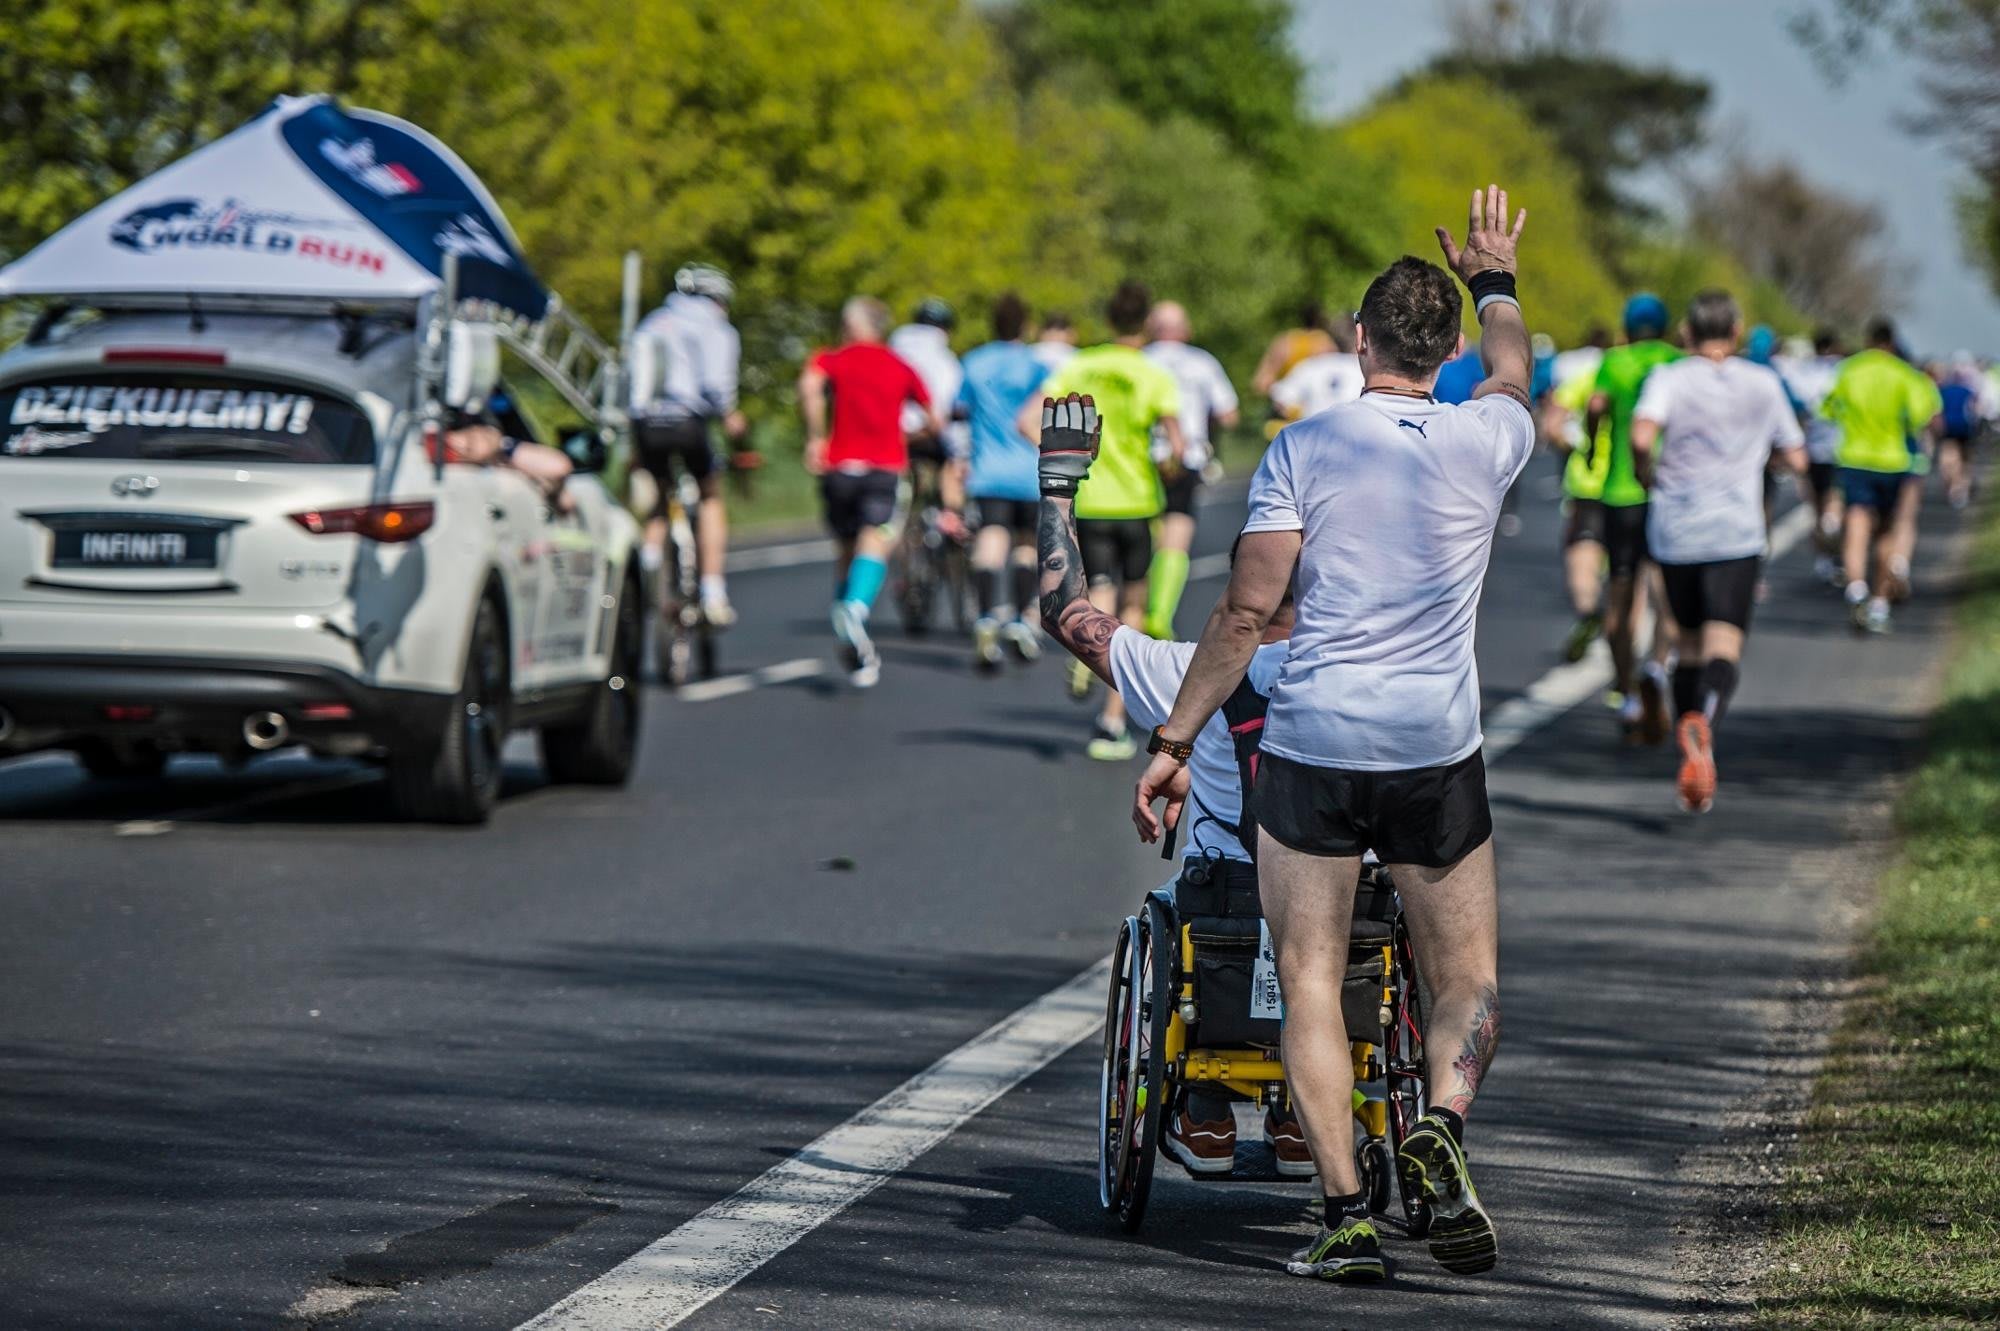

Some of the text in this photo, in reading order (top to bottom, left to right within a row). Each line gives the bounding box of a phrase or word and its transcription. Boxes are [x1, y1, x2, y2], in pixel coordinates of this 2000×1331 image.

[151, 218, 387, 273] WORLD RUN
[82, 532, 187, 562] INFINITI
[1266, 970, 1278, 1011] 150412
